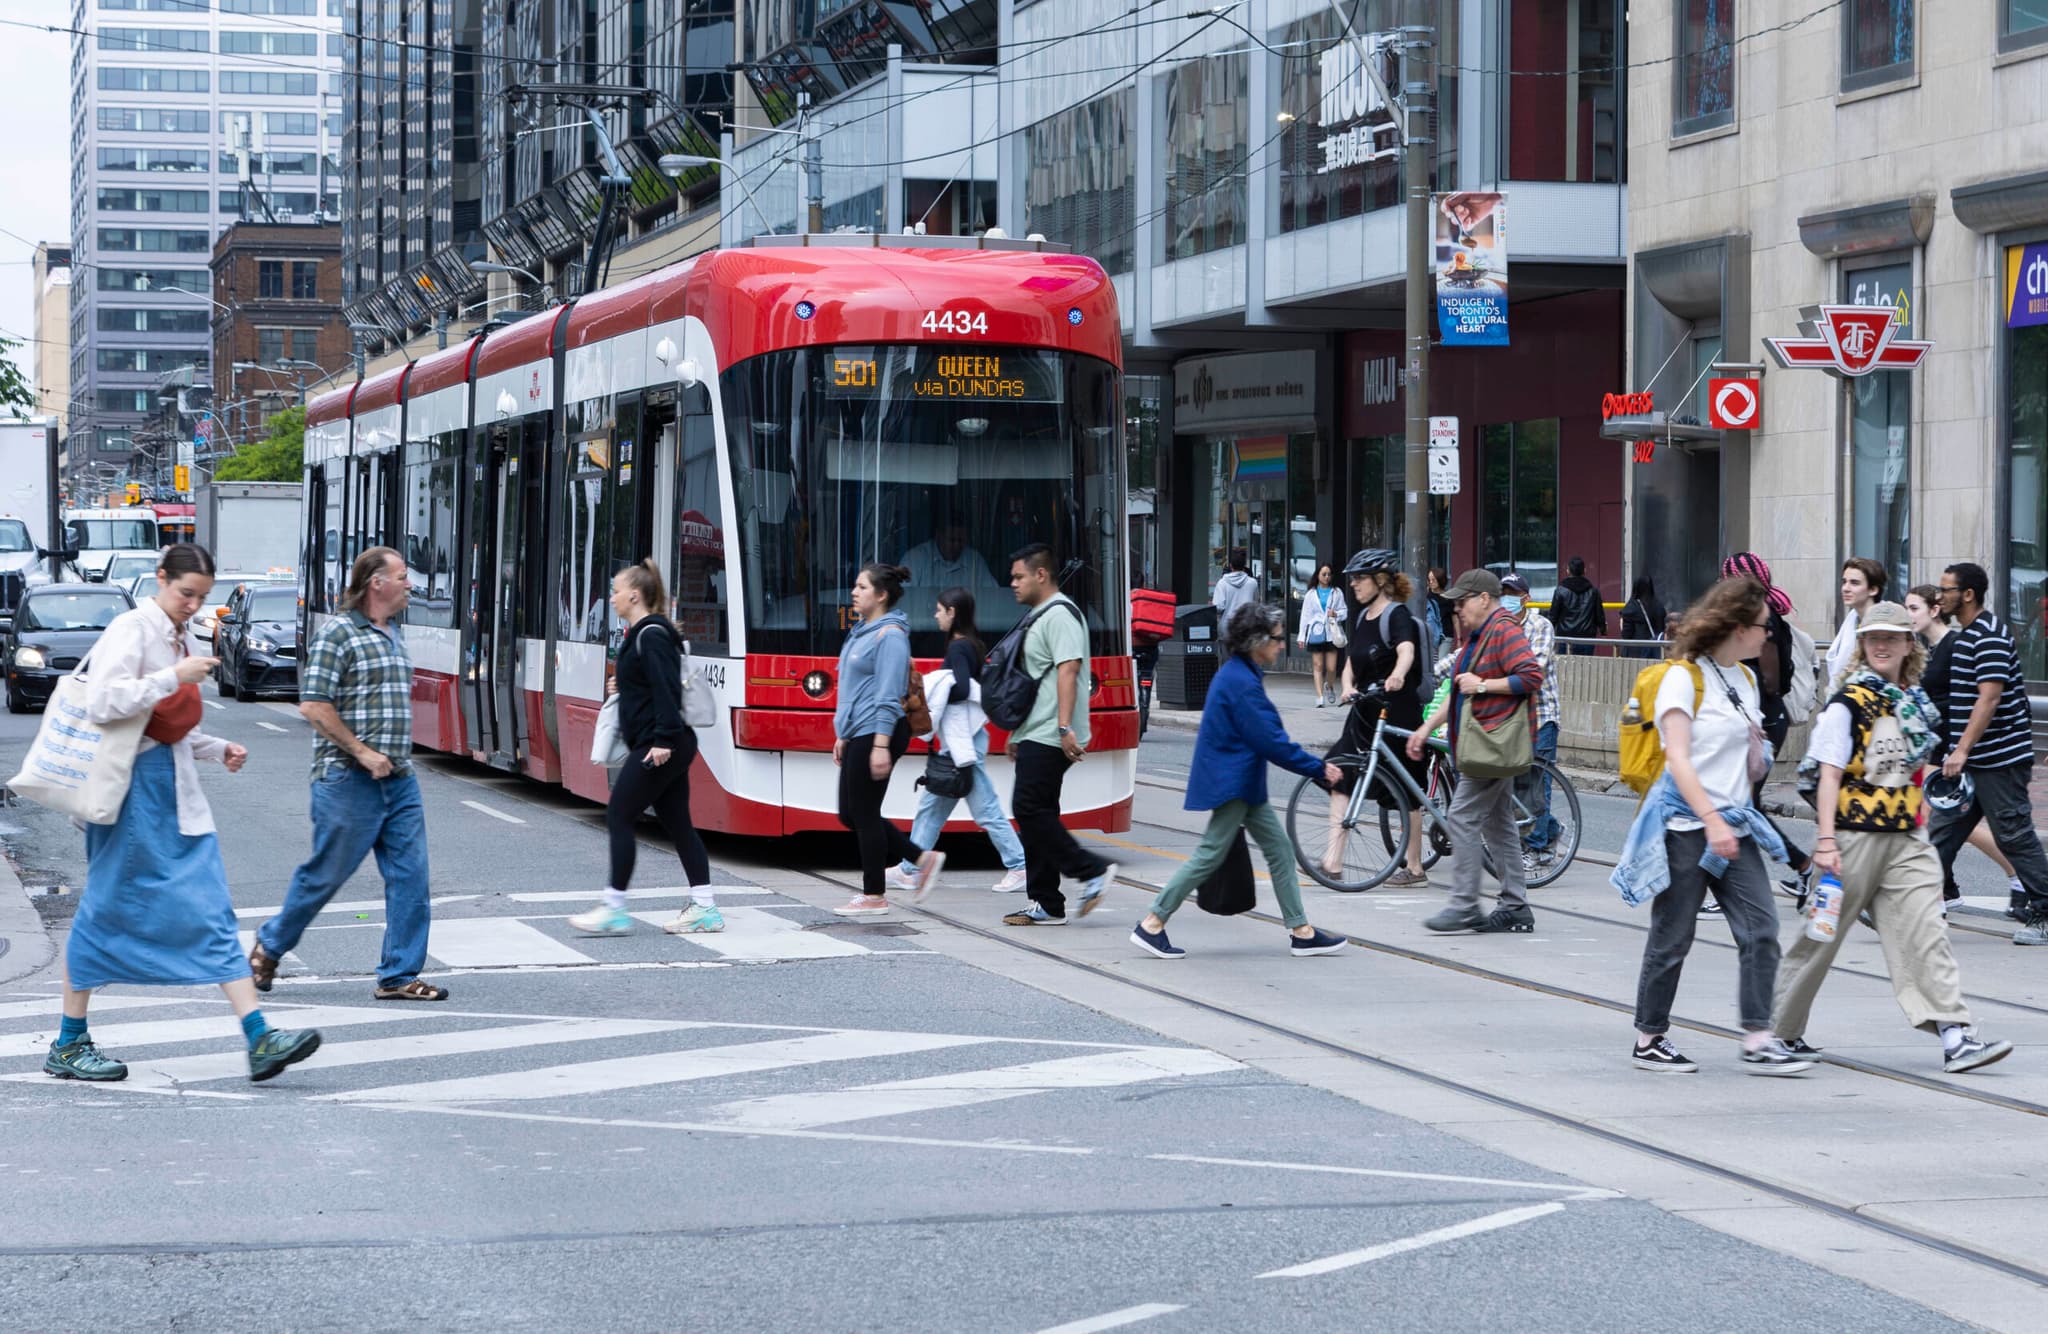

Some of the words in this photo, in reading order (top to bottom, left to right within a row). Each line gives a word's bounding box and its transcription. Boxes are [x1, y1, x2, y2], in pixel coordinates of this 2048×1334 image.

[1319, 35, 1383, 126] MUJI
[1441, 298, 1481, 306] INDULGE
[1484, 298, 1495, 306] IN
[1447, 306, 1500, 316] TORONTO'S
[921, 310, 988, 334] 4434
[1456, 324, 1486, 333] HEART
[1461, 316, 1507, 324] CULTURAL
[834, 360, 877, 386] 501
[938, 356, 1000, 377] QUEEN
[914, 379, 944, 396] via
[949, 380, 1025, 397] DUNDAS
[1364, 357, 1396, 404] MUJI
[1613, 391, 1654, 416] ROGERS
[1187, 645, 1204, 653] Litter
